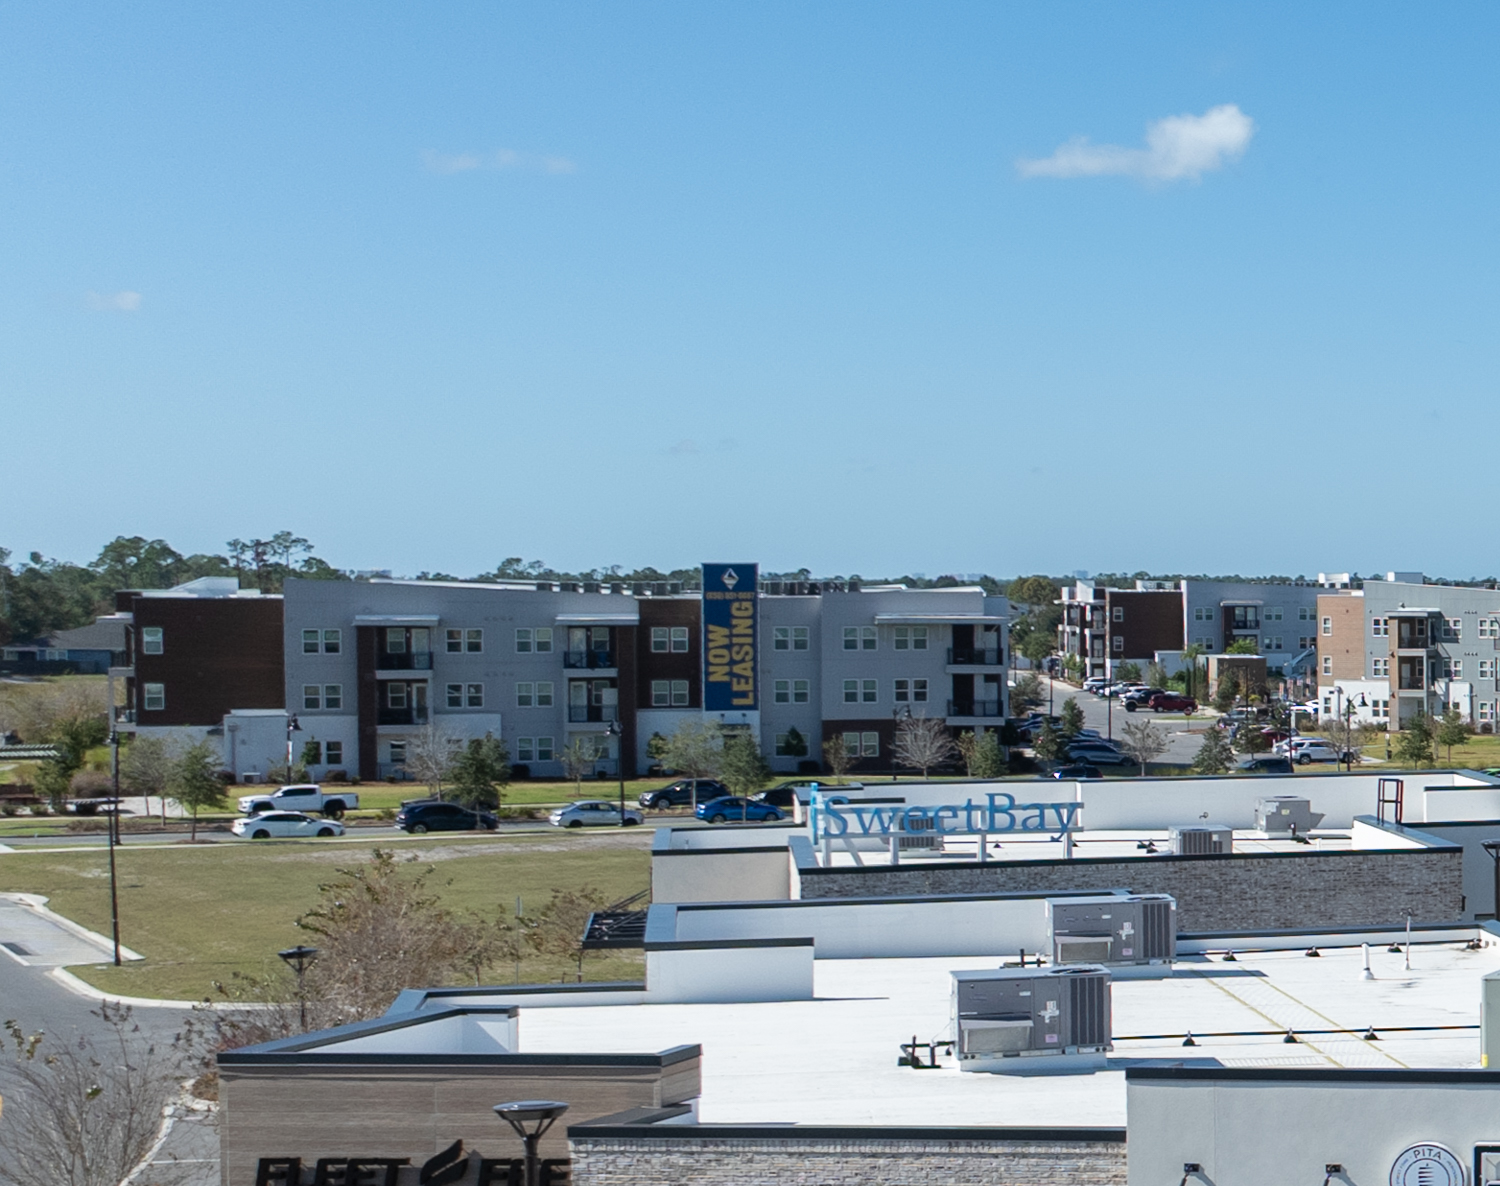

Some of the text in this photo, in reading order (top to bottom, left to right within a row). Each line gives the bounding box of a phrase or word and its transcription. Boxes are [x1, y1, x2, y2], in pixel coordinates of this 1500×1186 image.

[707, 624, 730, 682] NOW
[731, 601, 755, 706] LEASING
[824, 792, 1082, 842] SweetBay
[1413, 1148, 1442, 1160] PITA
